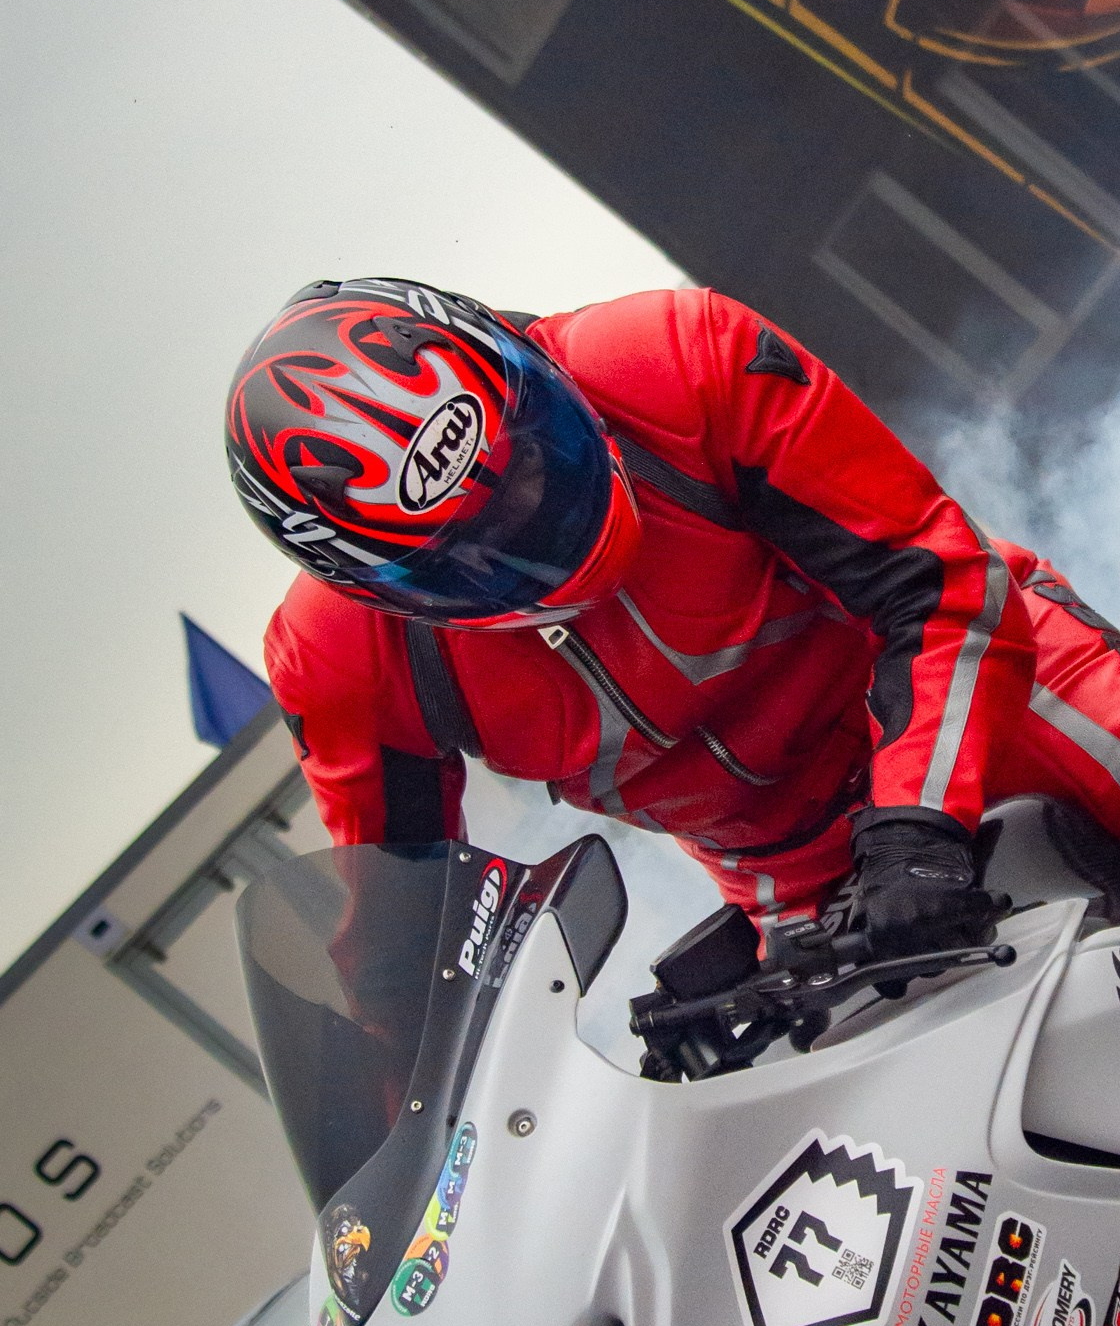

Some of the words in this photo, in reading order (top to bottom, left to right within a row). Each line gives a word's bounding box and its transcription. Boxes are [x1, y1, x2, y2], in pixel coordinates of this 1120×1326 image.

[413, 402, 472, 509] Arai
[458, 879, 499, 977] Puig
[921, 1168, 947, 1225] МАСЛА
[769, 1211, 843, 1287] 77
[402, 1271, 424, 1302] M-3
[1020, 1291, 1028, 1305] ПО
